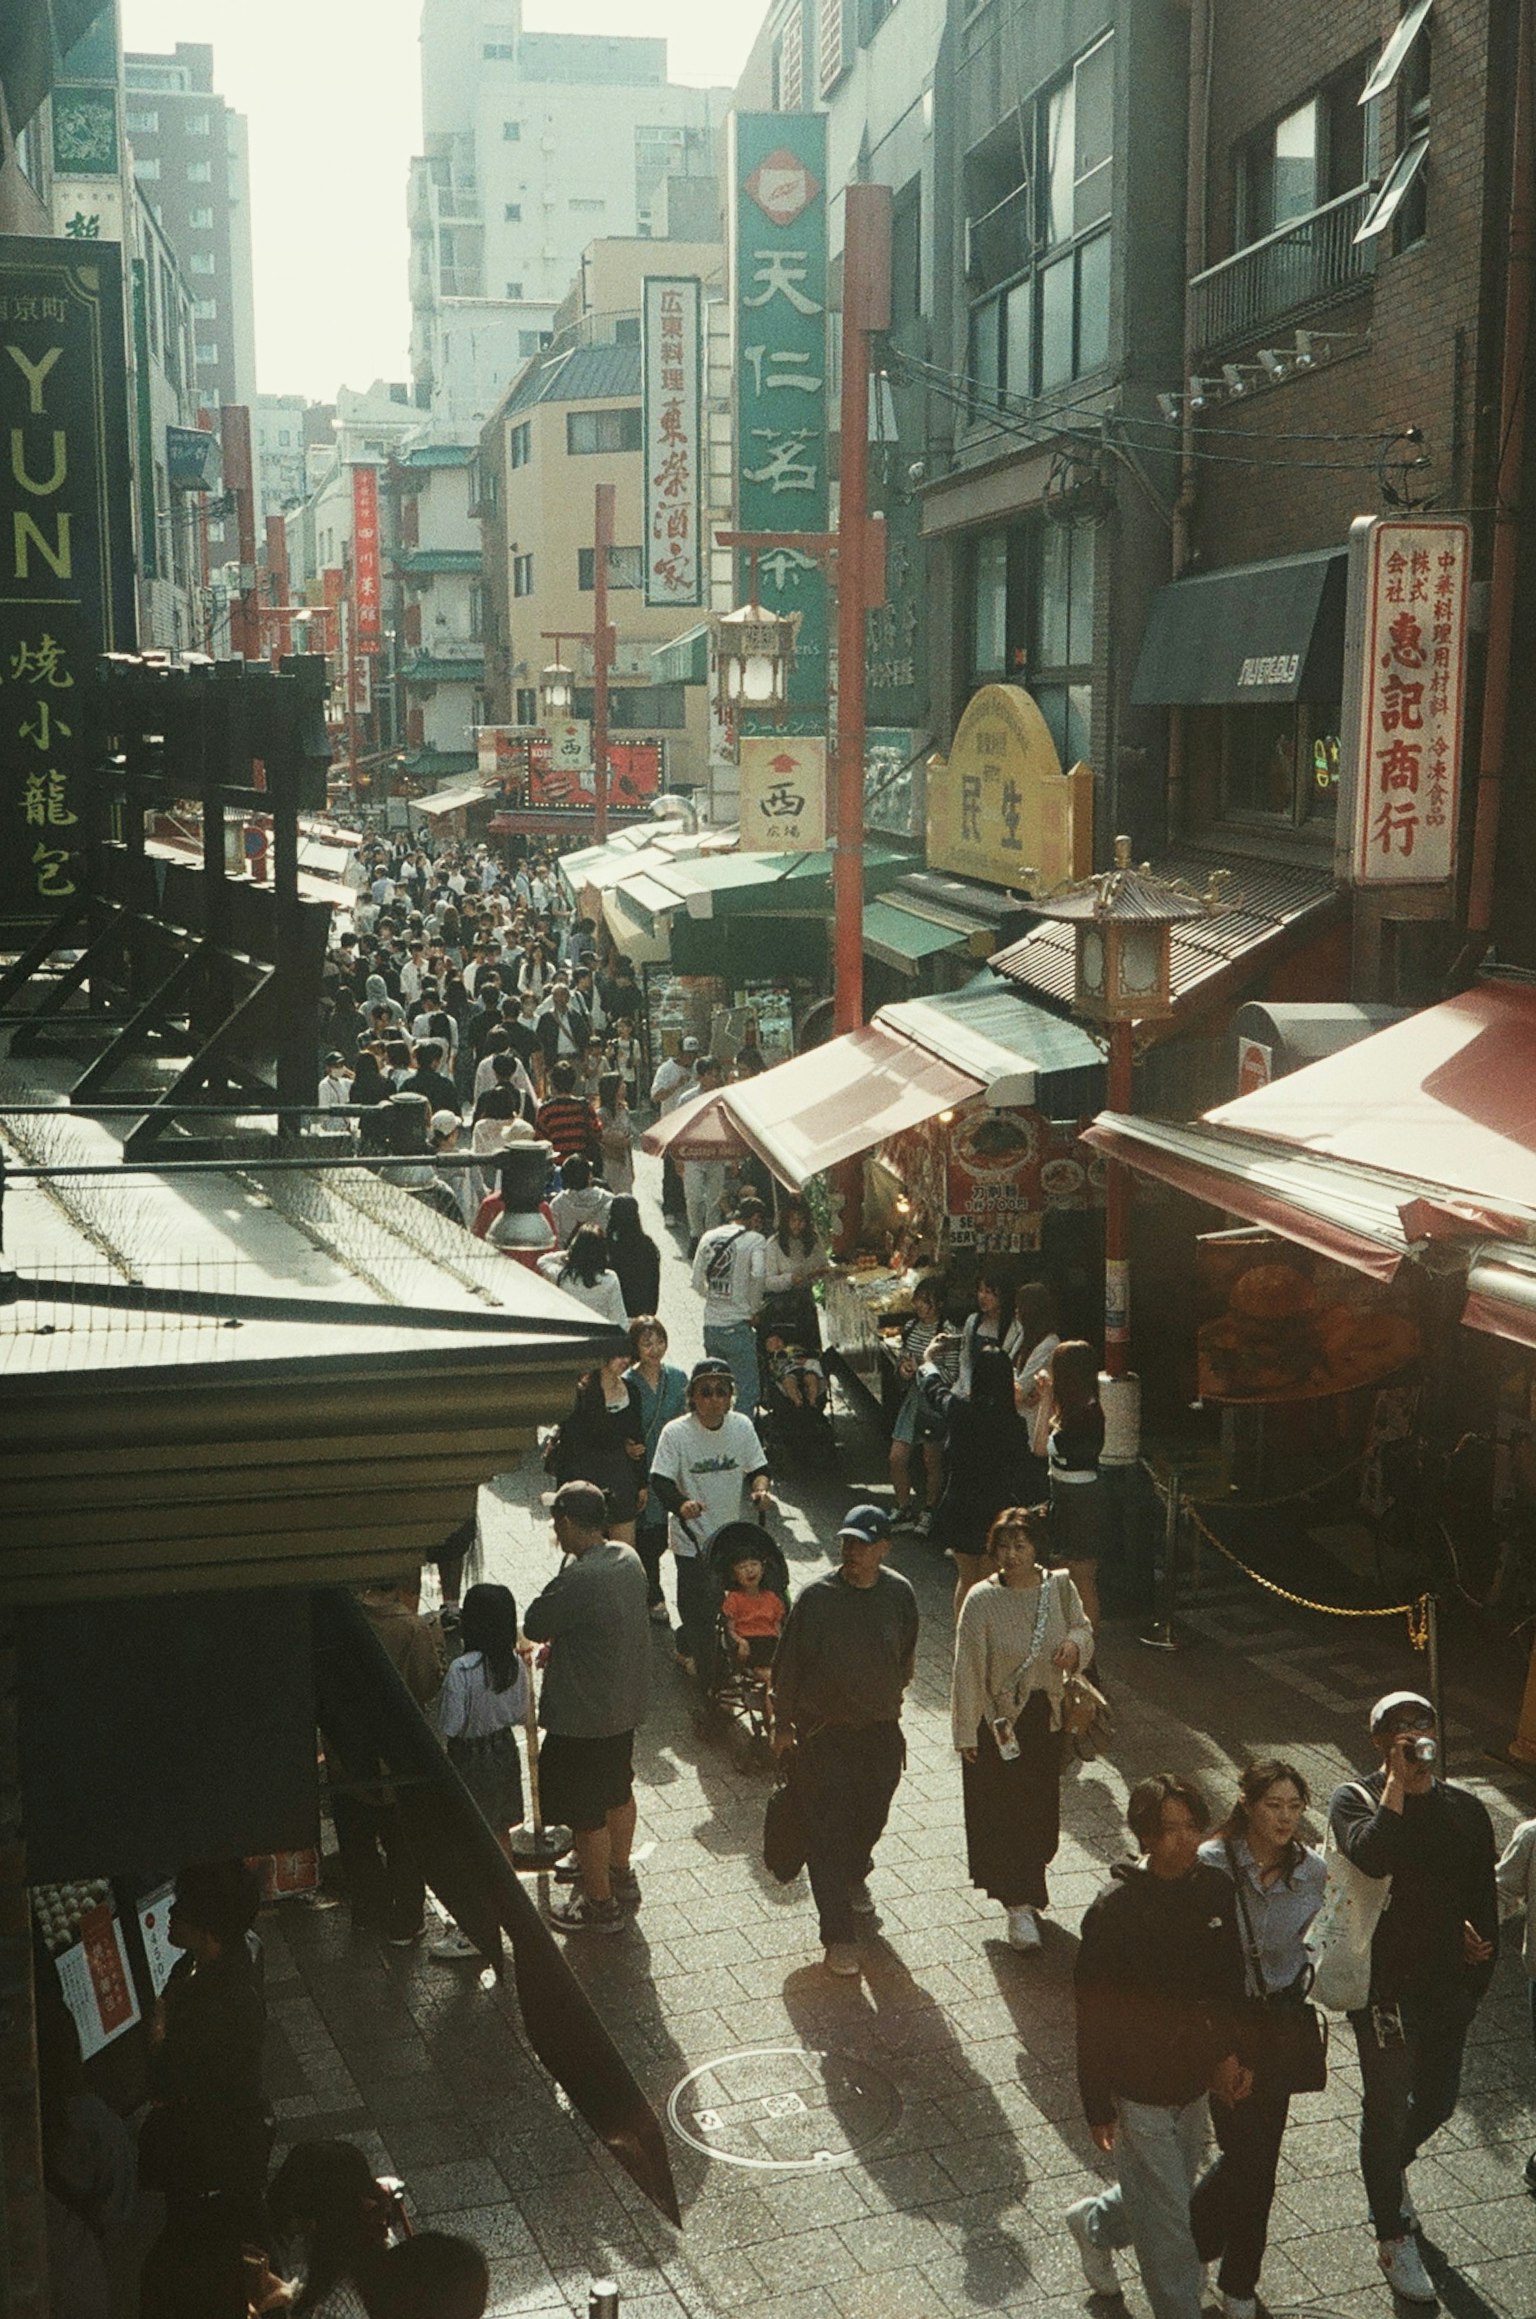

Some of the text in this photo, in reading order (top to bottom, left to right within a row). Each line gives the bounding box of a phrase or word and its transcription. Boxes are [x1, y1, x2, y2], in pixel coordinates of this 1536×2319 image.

[660, 289, 685, 392] 広東料理
[4, 345, 72, 579] YUN
[759, 781, 806, 818] 西
